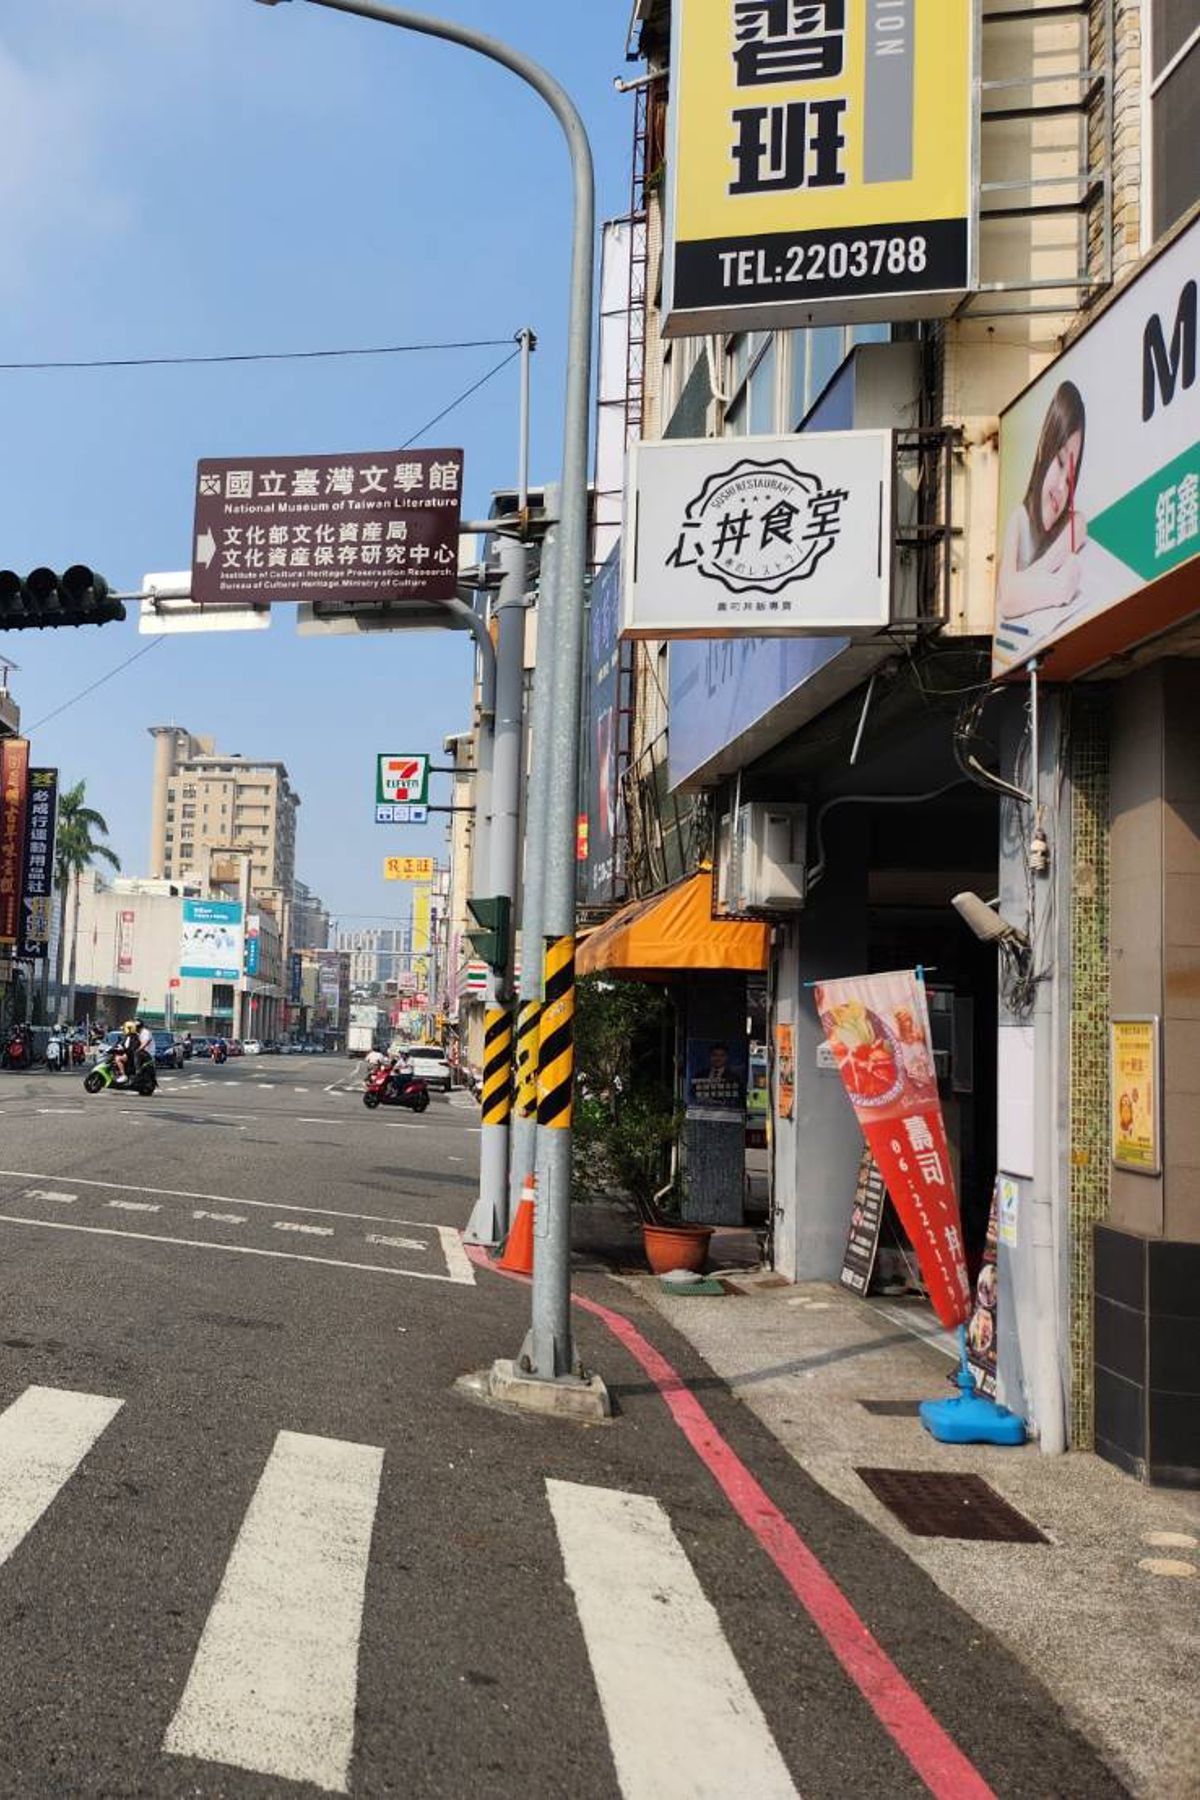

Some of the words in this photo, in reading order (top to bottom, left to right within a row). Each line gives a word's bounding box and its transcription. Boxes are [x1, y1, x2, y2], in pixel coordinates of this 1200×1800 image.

[718, 235, 927, 288] TEL:2203788
[225, 461, 461, 499] 國立臺灣文學館
[224, 502, 275, 514] National
[277, 501, 329, 512] Museum
[332, 500, 345, 511] of
[348, 499, 391, 510] Taiwan
[394, 497, 459, 509] Literature
[223, 520, 408, 546] 文化部文化資產局
[221, 543, 456, 568] 文化資產保存研究中心
[392, 578, 427, 587] Culture
